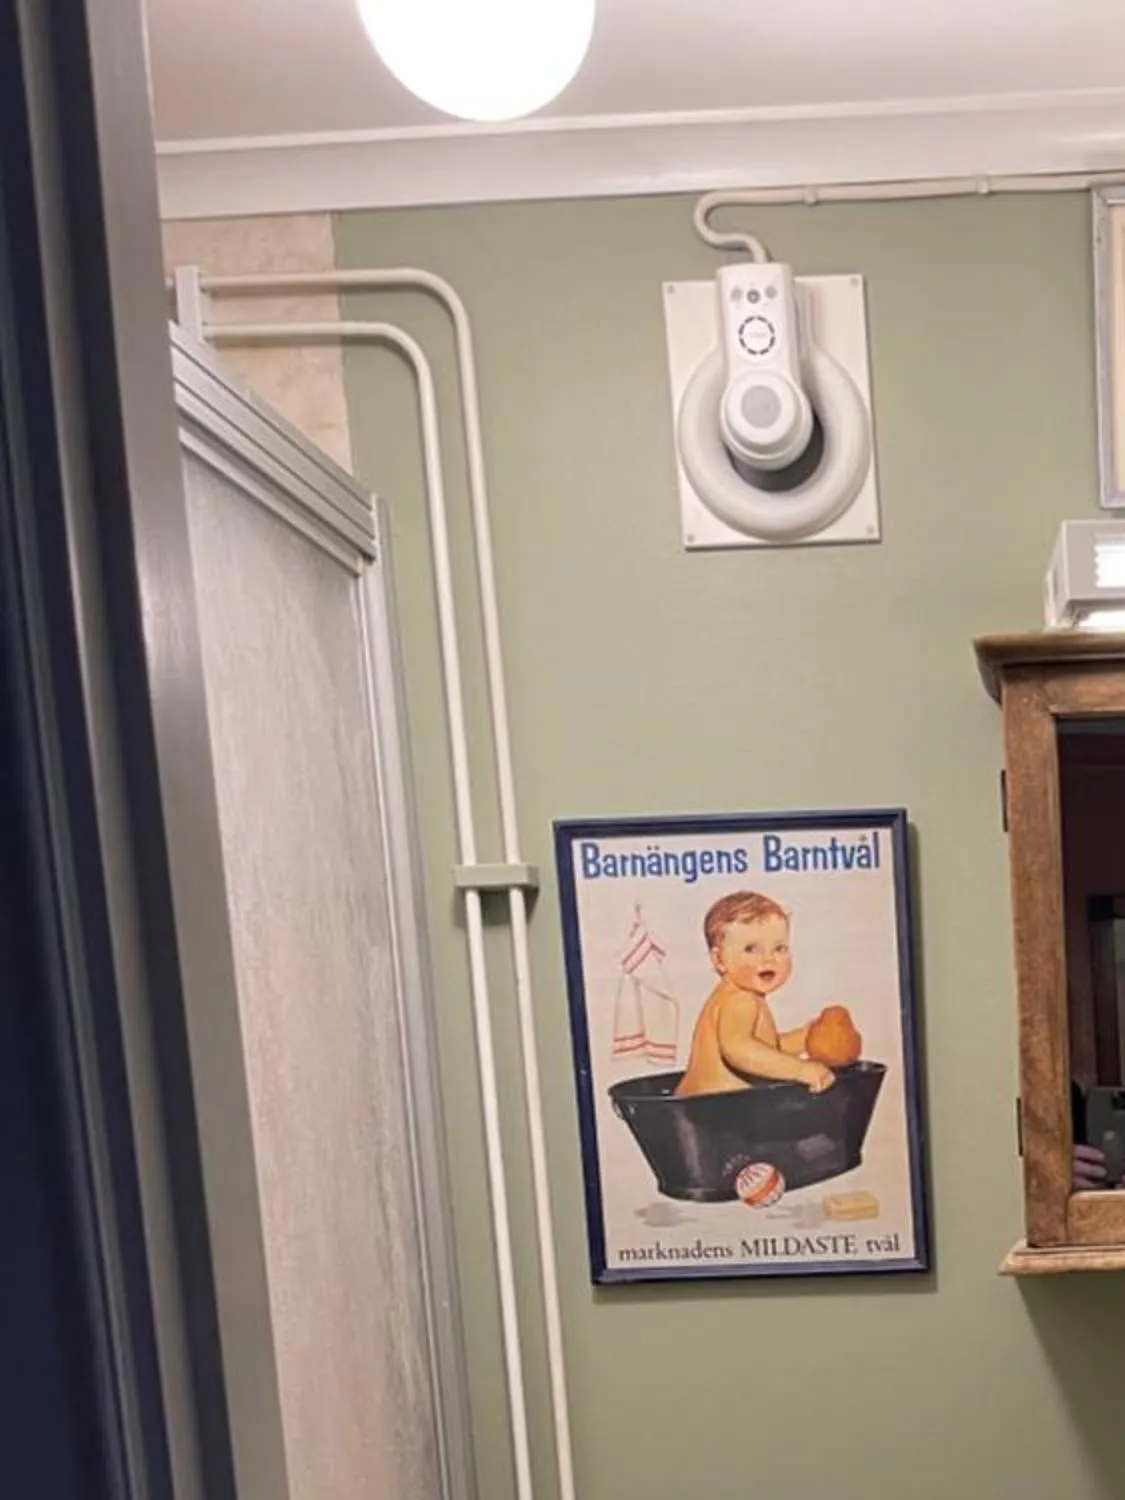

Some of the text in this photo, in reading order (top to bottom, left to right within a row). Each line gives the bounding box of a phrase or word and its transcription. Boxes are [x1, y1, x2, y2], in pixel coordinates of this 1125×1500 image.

[580, 831, 879, 883] Barnängens Barntvål
[618, 1239, 733, 1262] marknadens
[740, 1234, 858, 1257] MILDASTE
